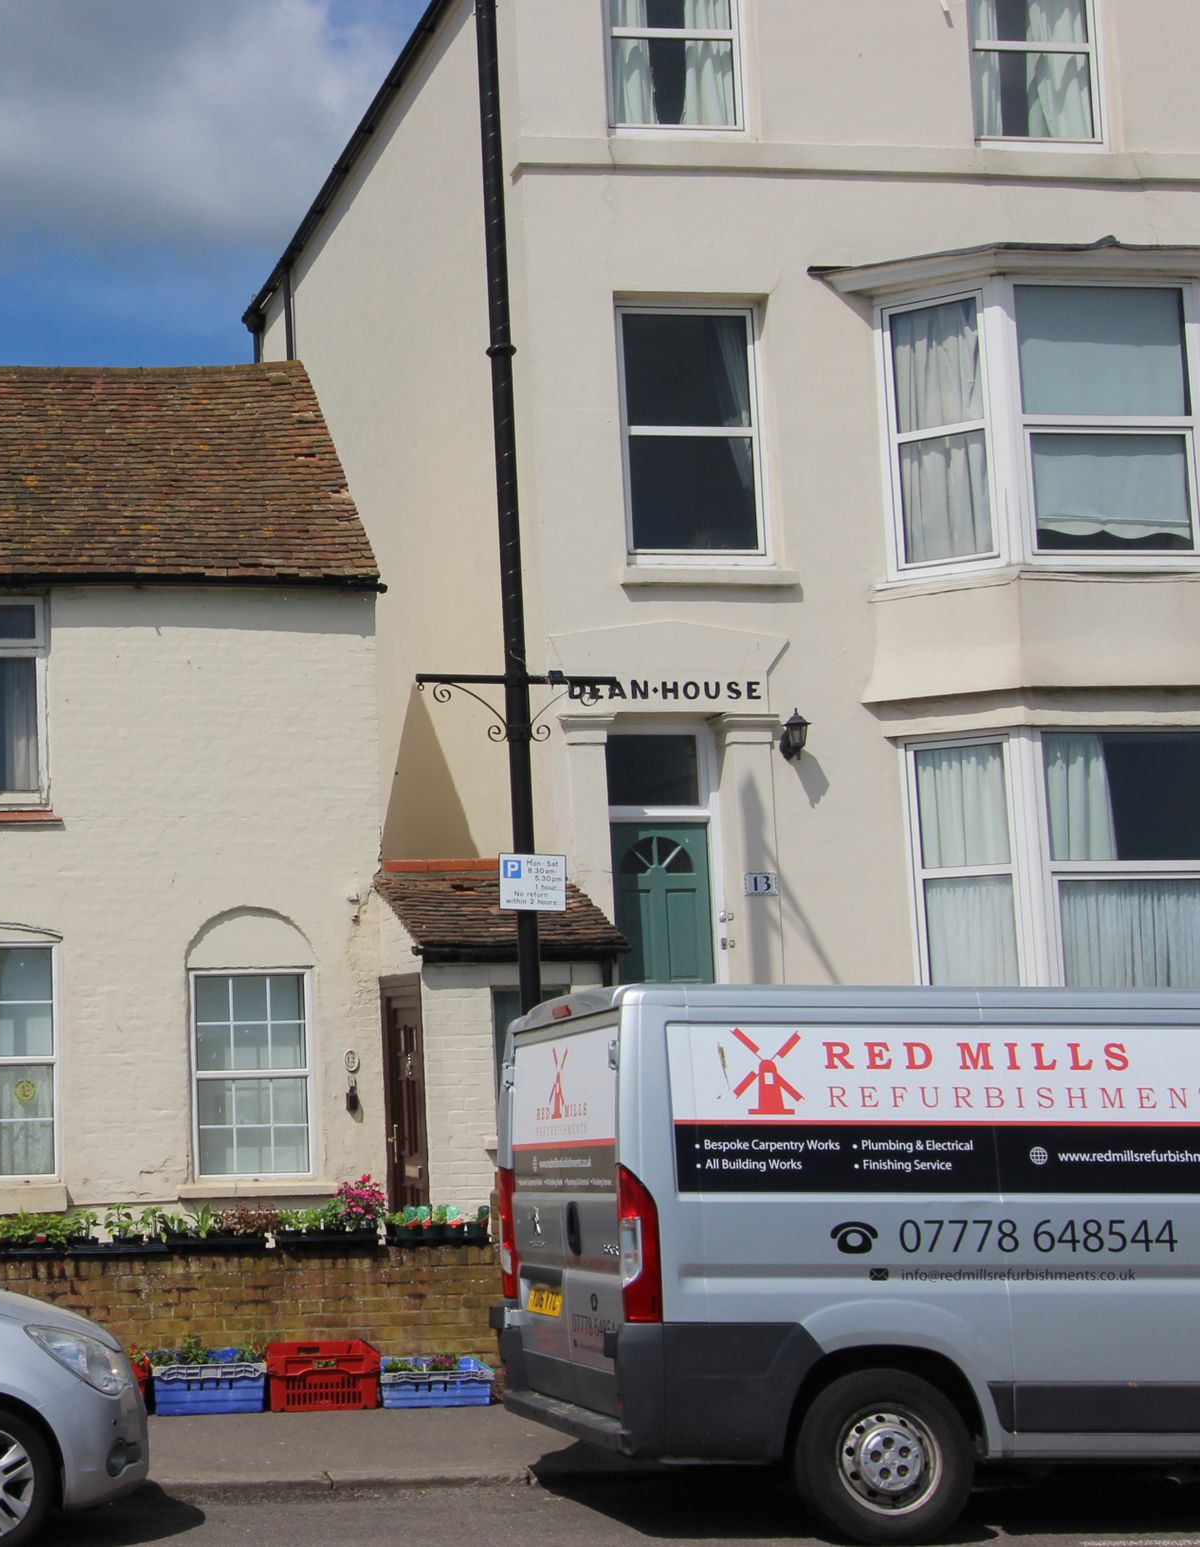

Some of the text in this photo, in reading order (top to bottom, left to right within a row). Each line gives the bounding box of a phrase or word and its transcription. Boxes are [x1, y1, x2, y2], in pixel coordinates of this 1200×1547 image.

[568, 679, 762, 700] DEAN HOUSE
[506, 861, 519, 878] P
[752, 875, 772, 892] 13
[822, 1041, 1130, 1072] RED MILLS
[826, 1086, 1200, 1110] REFURBISHMEN
[703, 1139, 841, 1154] Bespoke Carpentry Works
[861, 1139, 975, 1154] Plumbing & Electrical
[705, 1158, 803, 1173] All Building Works
[862, 1158, 953, 1174] Finishing Service
[899, 1218, 1180, 1255] 07778 648544
[900, 1267, 1137, 1283] info@redmillsrefurbishments.co.uk
